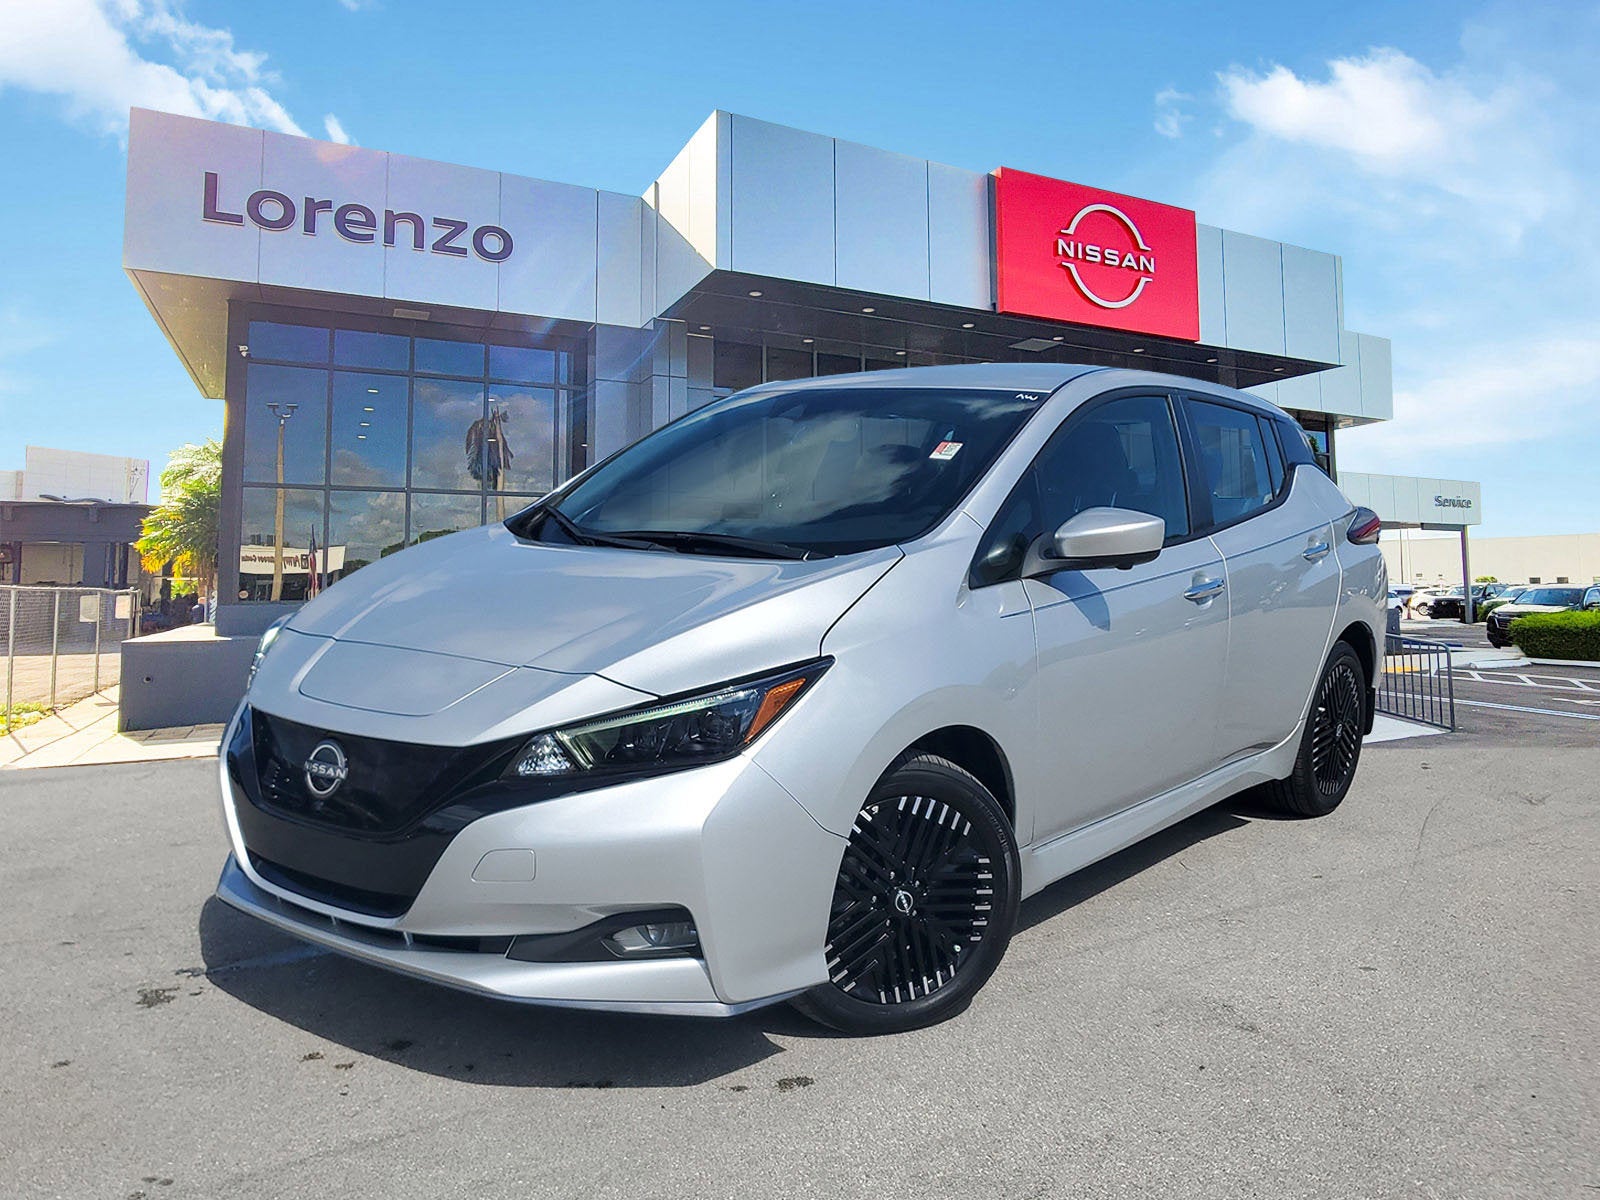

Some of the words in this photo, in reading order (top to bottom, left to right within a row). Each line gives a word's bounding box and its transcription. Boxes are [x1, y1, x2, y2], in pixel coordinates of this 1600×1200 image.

[202, 171, 515, 262] Lorenzo
[1057, 238, 1155, 273] NISSAN
[1434, 495, 1472, 508] Service
